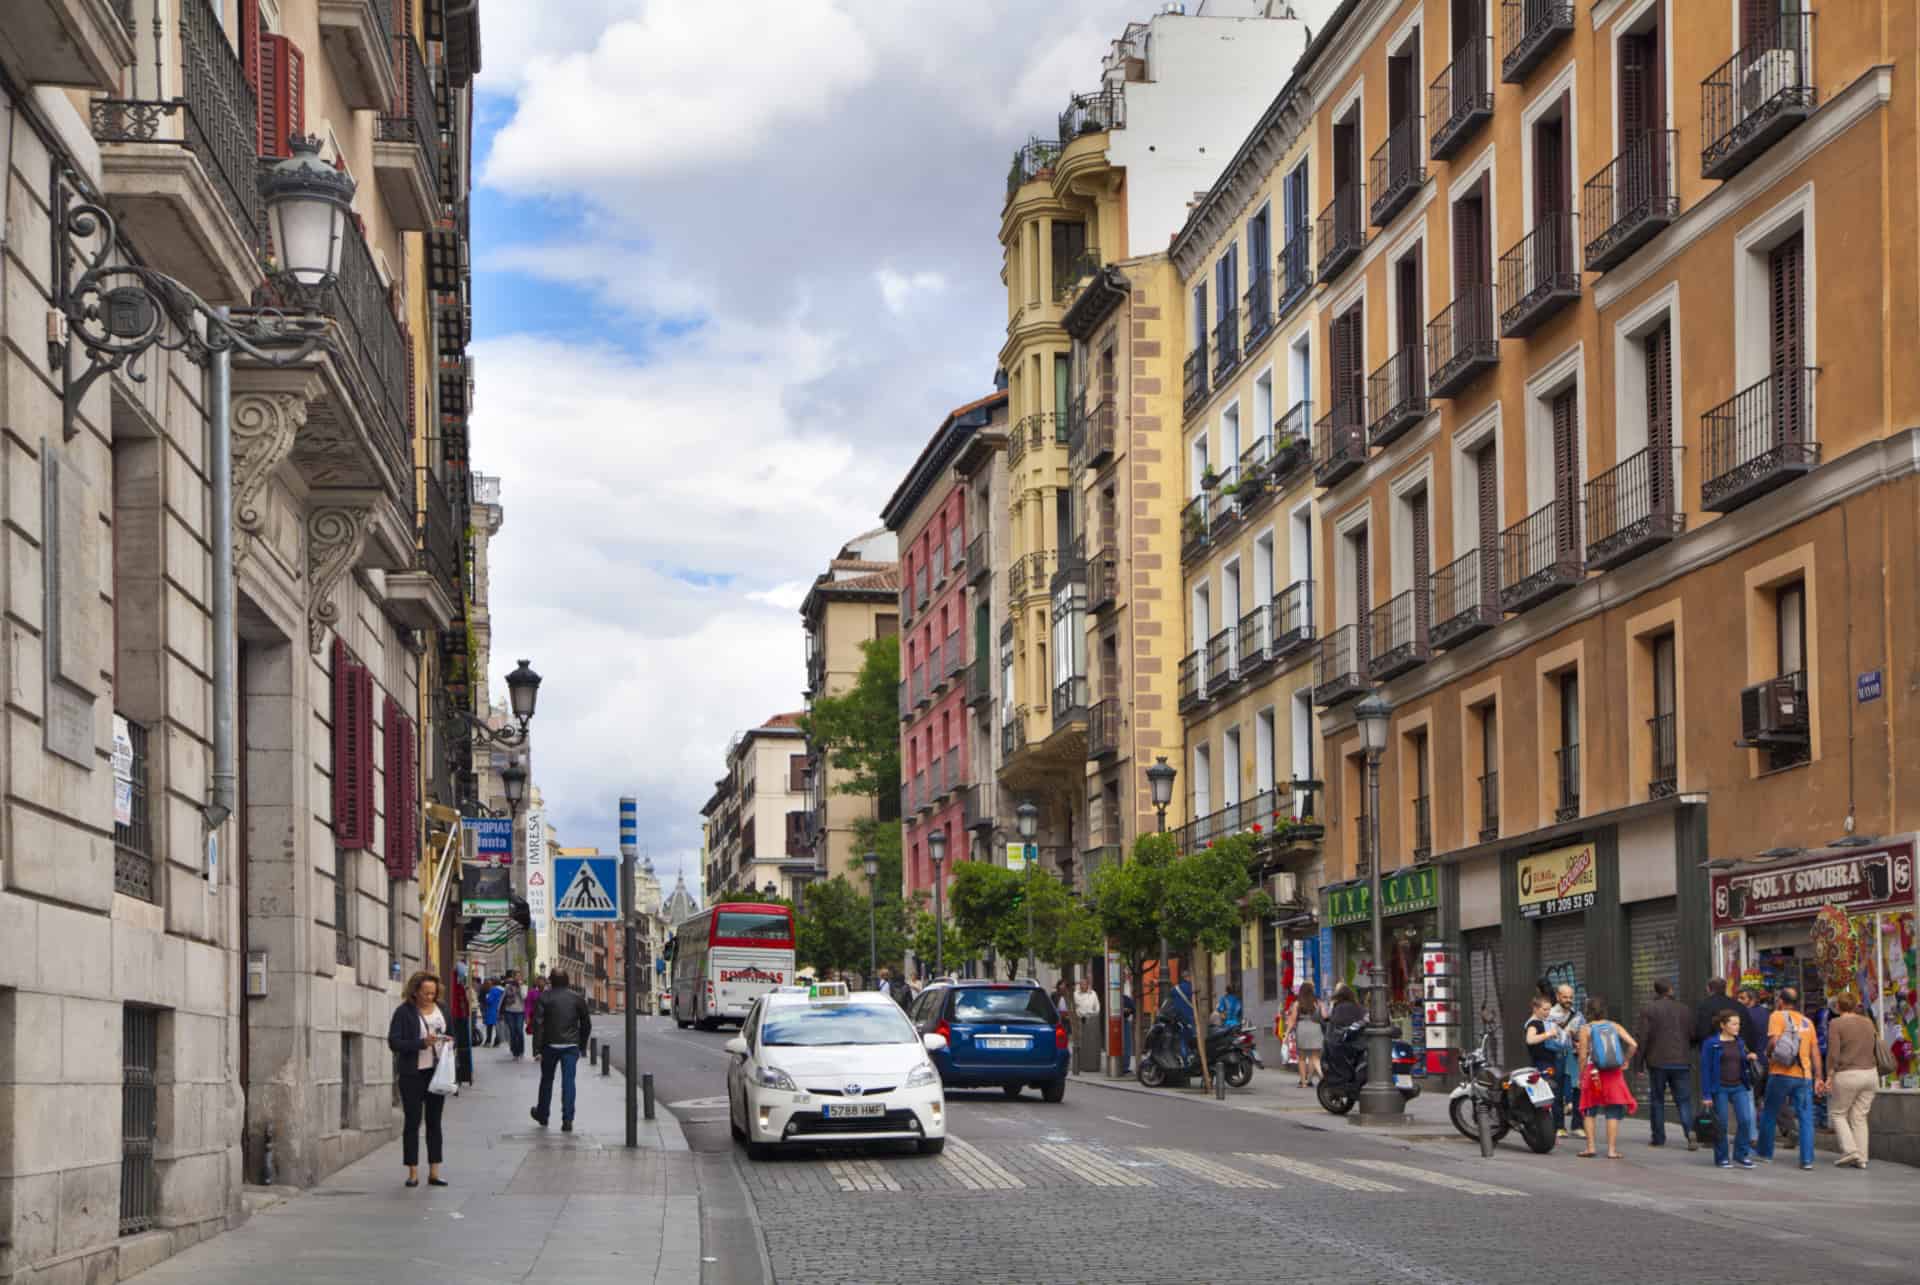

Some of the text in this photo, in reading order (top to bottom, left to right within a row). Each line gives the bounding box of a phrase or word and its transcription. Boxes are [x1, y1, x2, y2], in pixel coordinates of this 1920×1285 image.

[529, 814, 540, 865] IMRESA
[1752, 862, 1861, 899] SOL Y SOMBRA
[1584, 893, 1594, 907] 50
